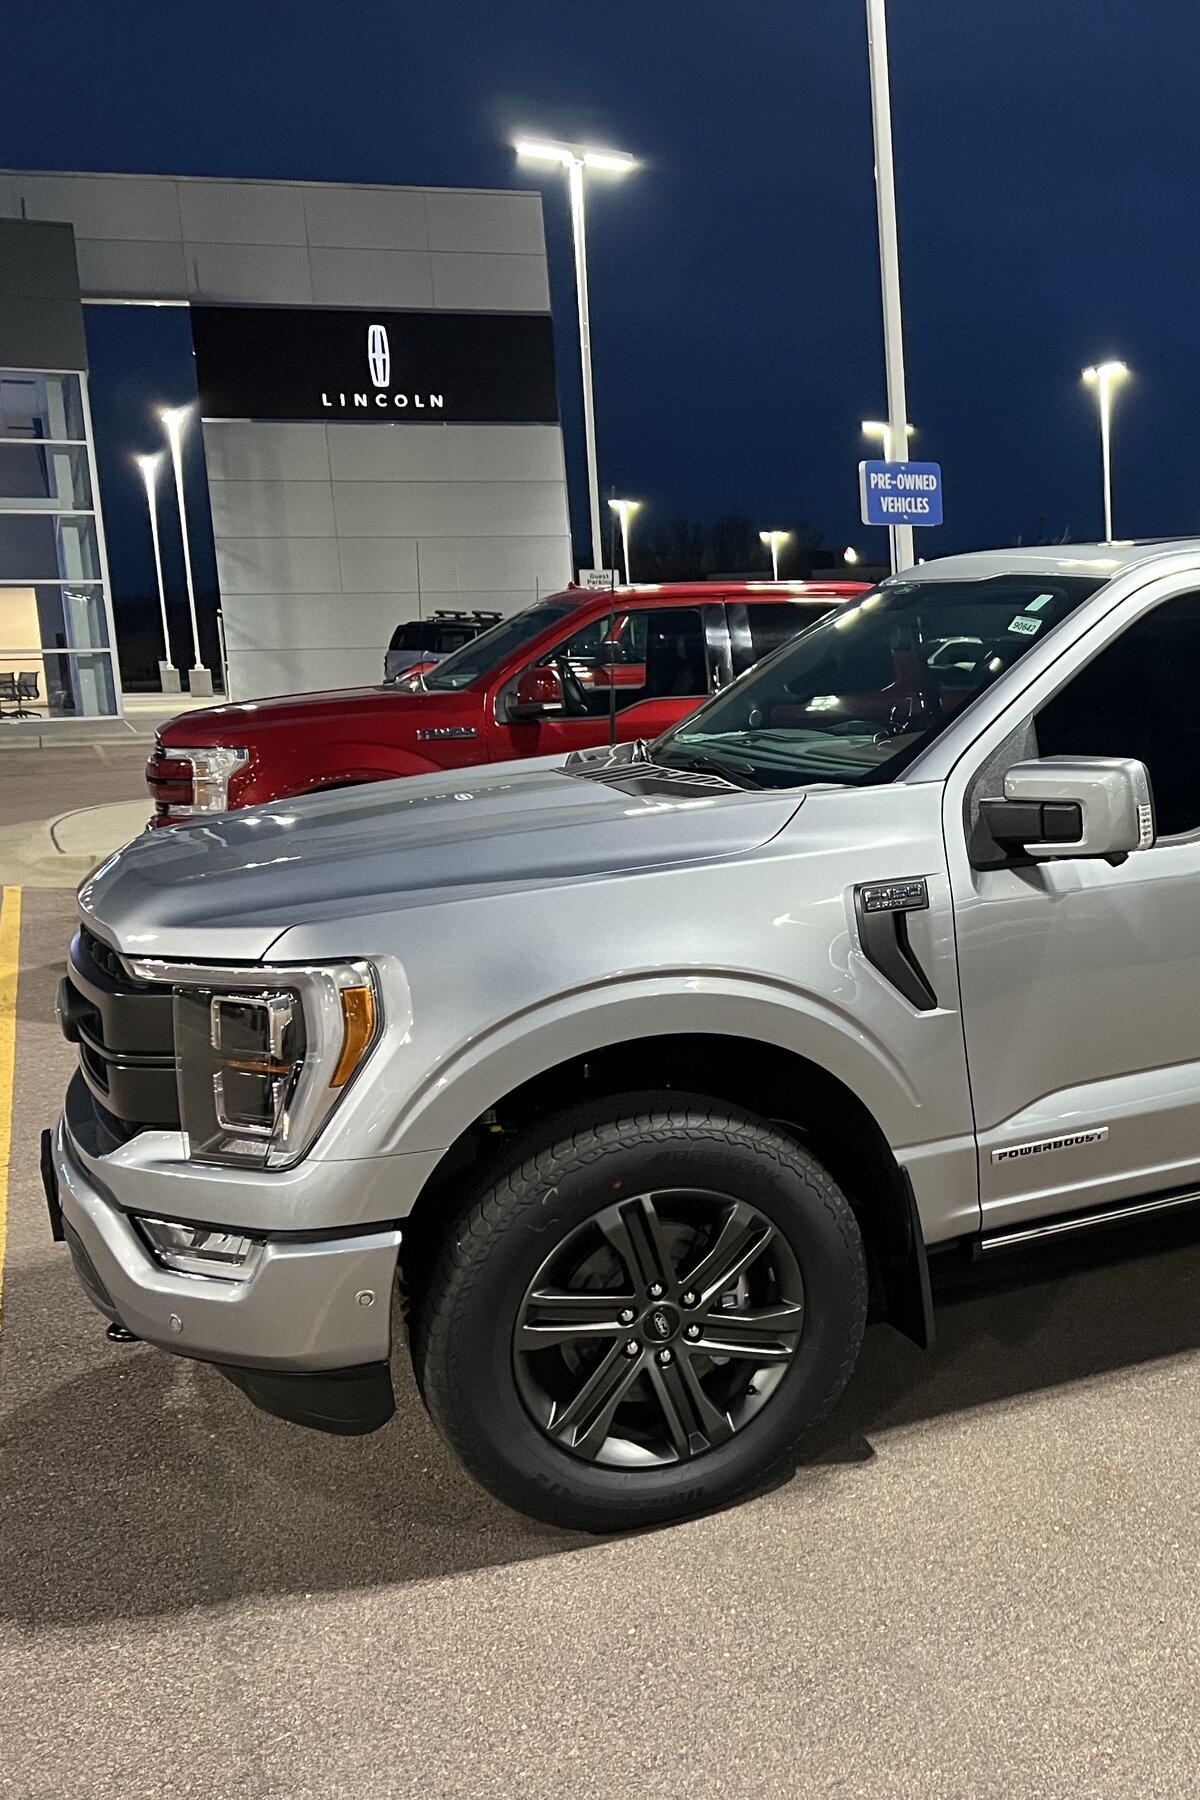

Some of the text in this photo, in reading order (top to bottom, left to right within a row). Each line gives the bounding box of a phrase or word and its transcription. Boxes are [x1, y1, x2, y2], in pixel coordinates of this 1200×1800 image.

[321, 393, 444, 408] LINCOLN
[870, 472, 937, 491] PRE-OWNED
[880, 496, 930, 513] VEHICLES
[1012, 621, 1036, 633] 90642
[998, 1131, 1104, 1161] POWERBOOST
